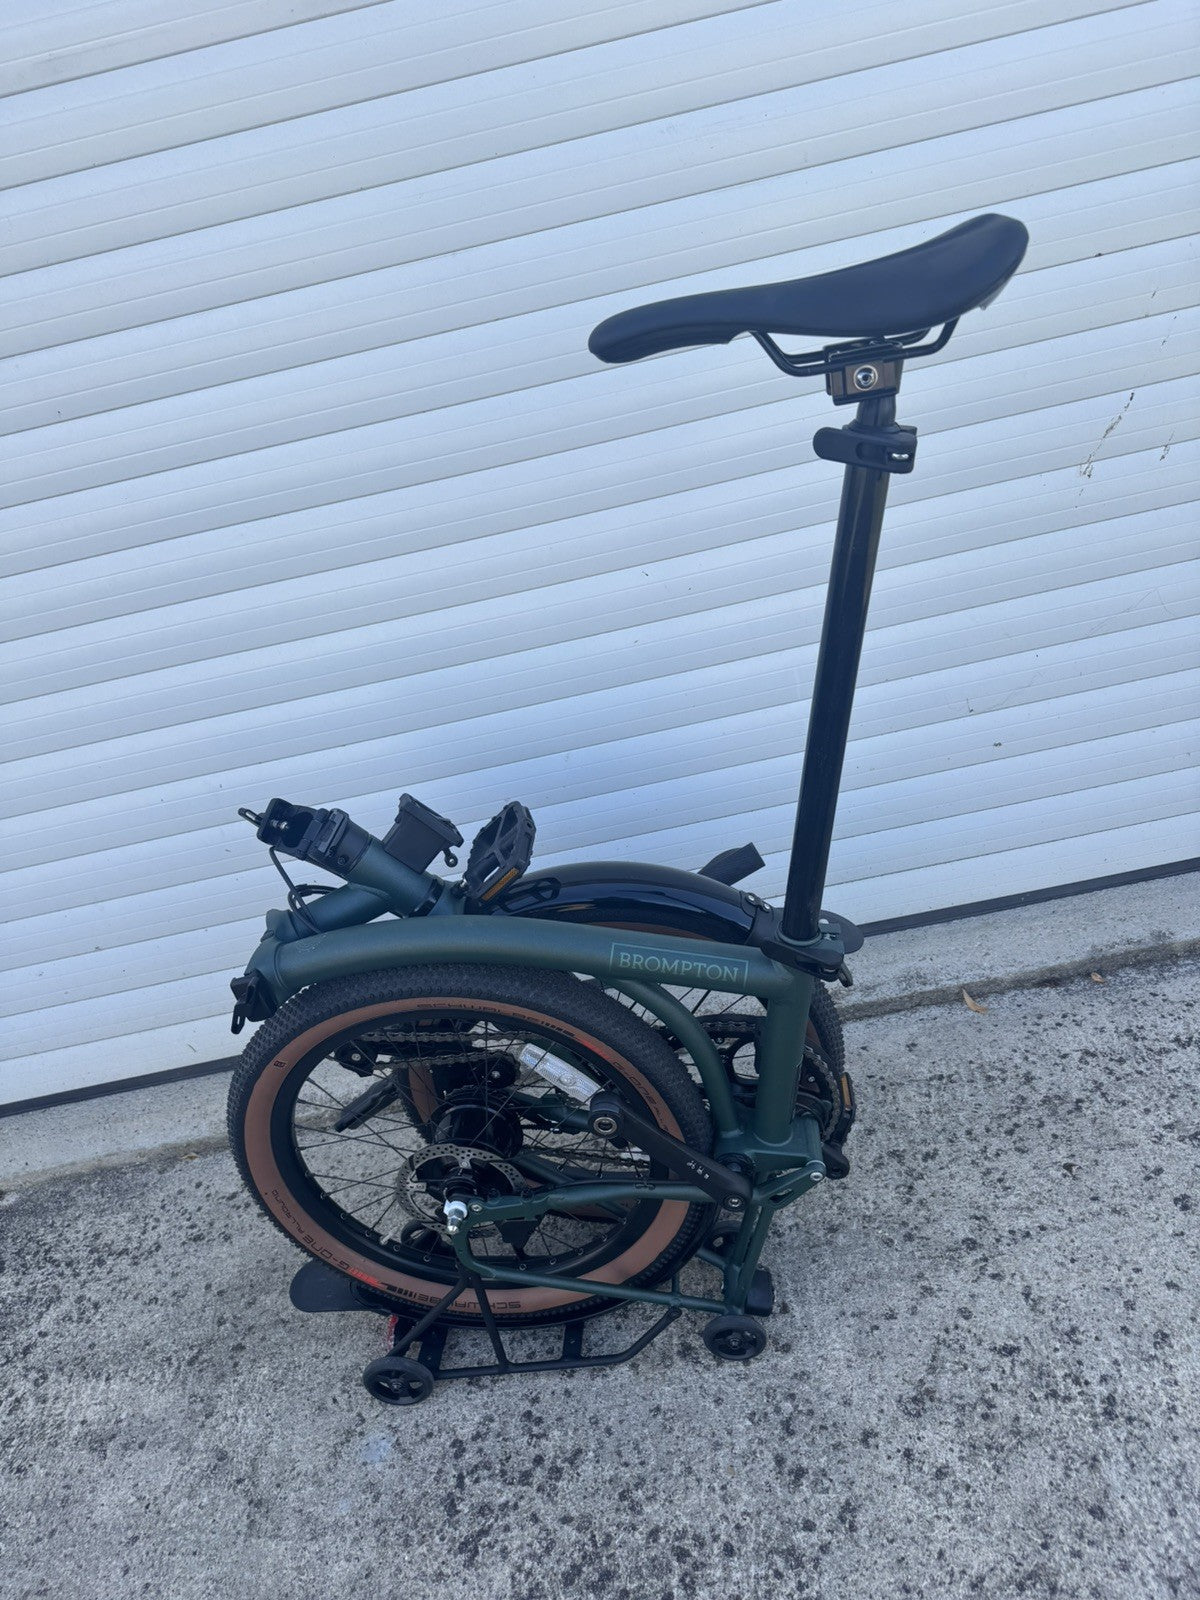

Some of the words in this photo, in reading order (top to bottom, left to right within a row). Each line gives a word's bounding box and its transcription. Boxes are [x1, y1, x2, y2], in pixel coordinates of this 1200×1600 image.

[619, 952, 739, 982] BROMPTON
[302, 1235, 350, 1271] G-ONE
[419, 1294, 522, 1310] SCHWABE
